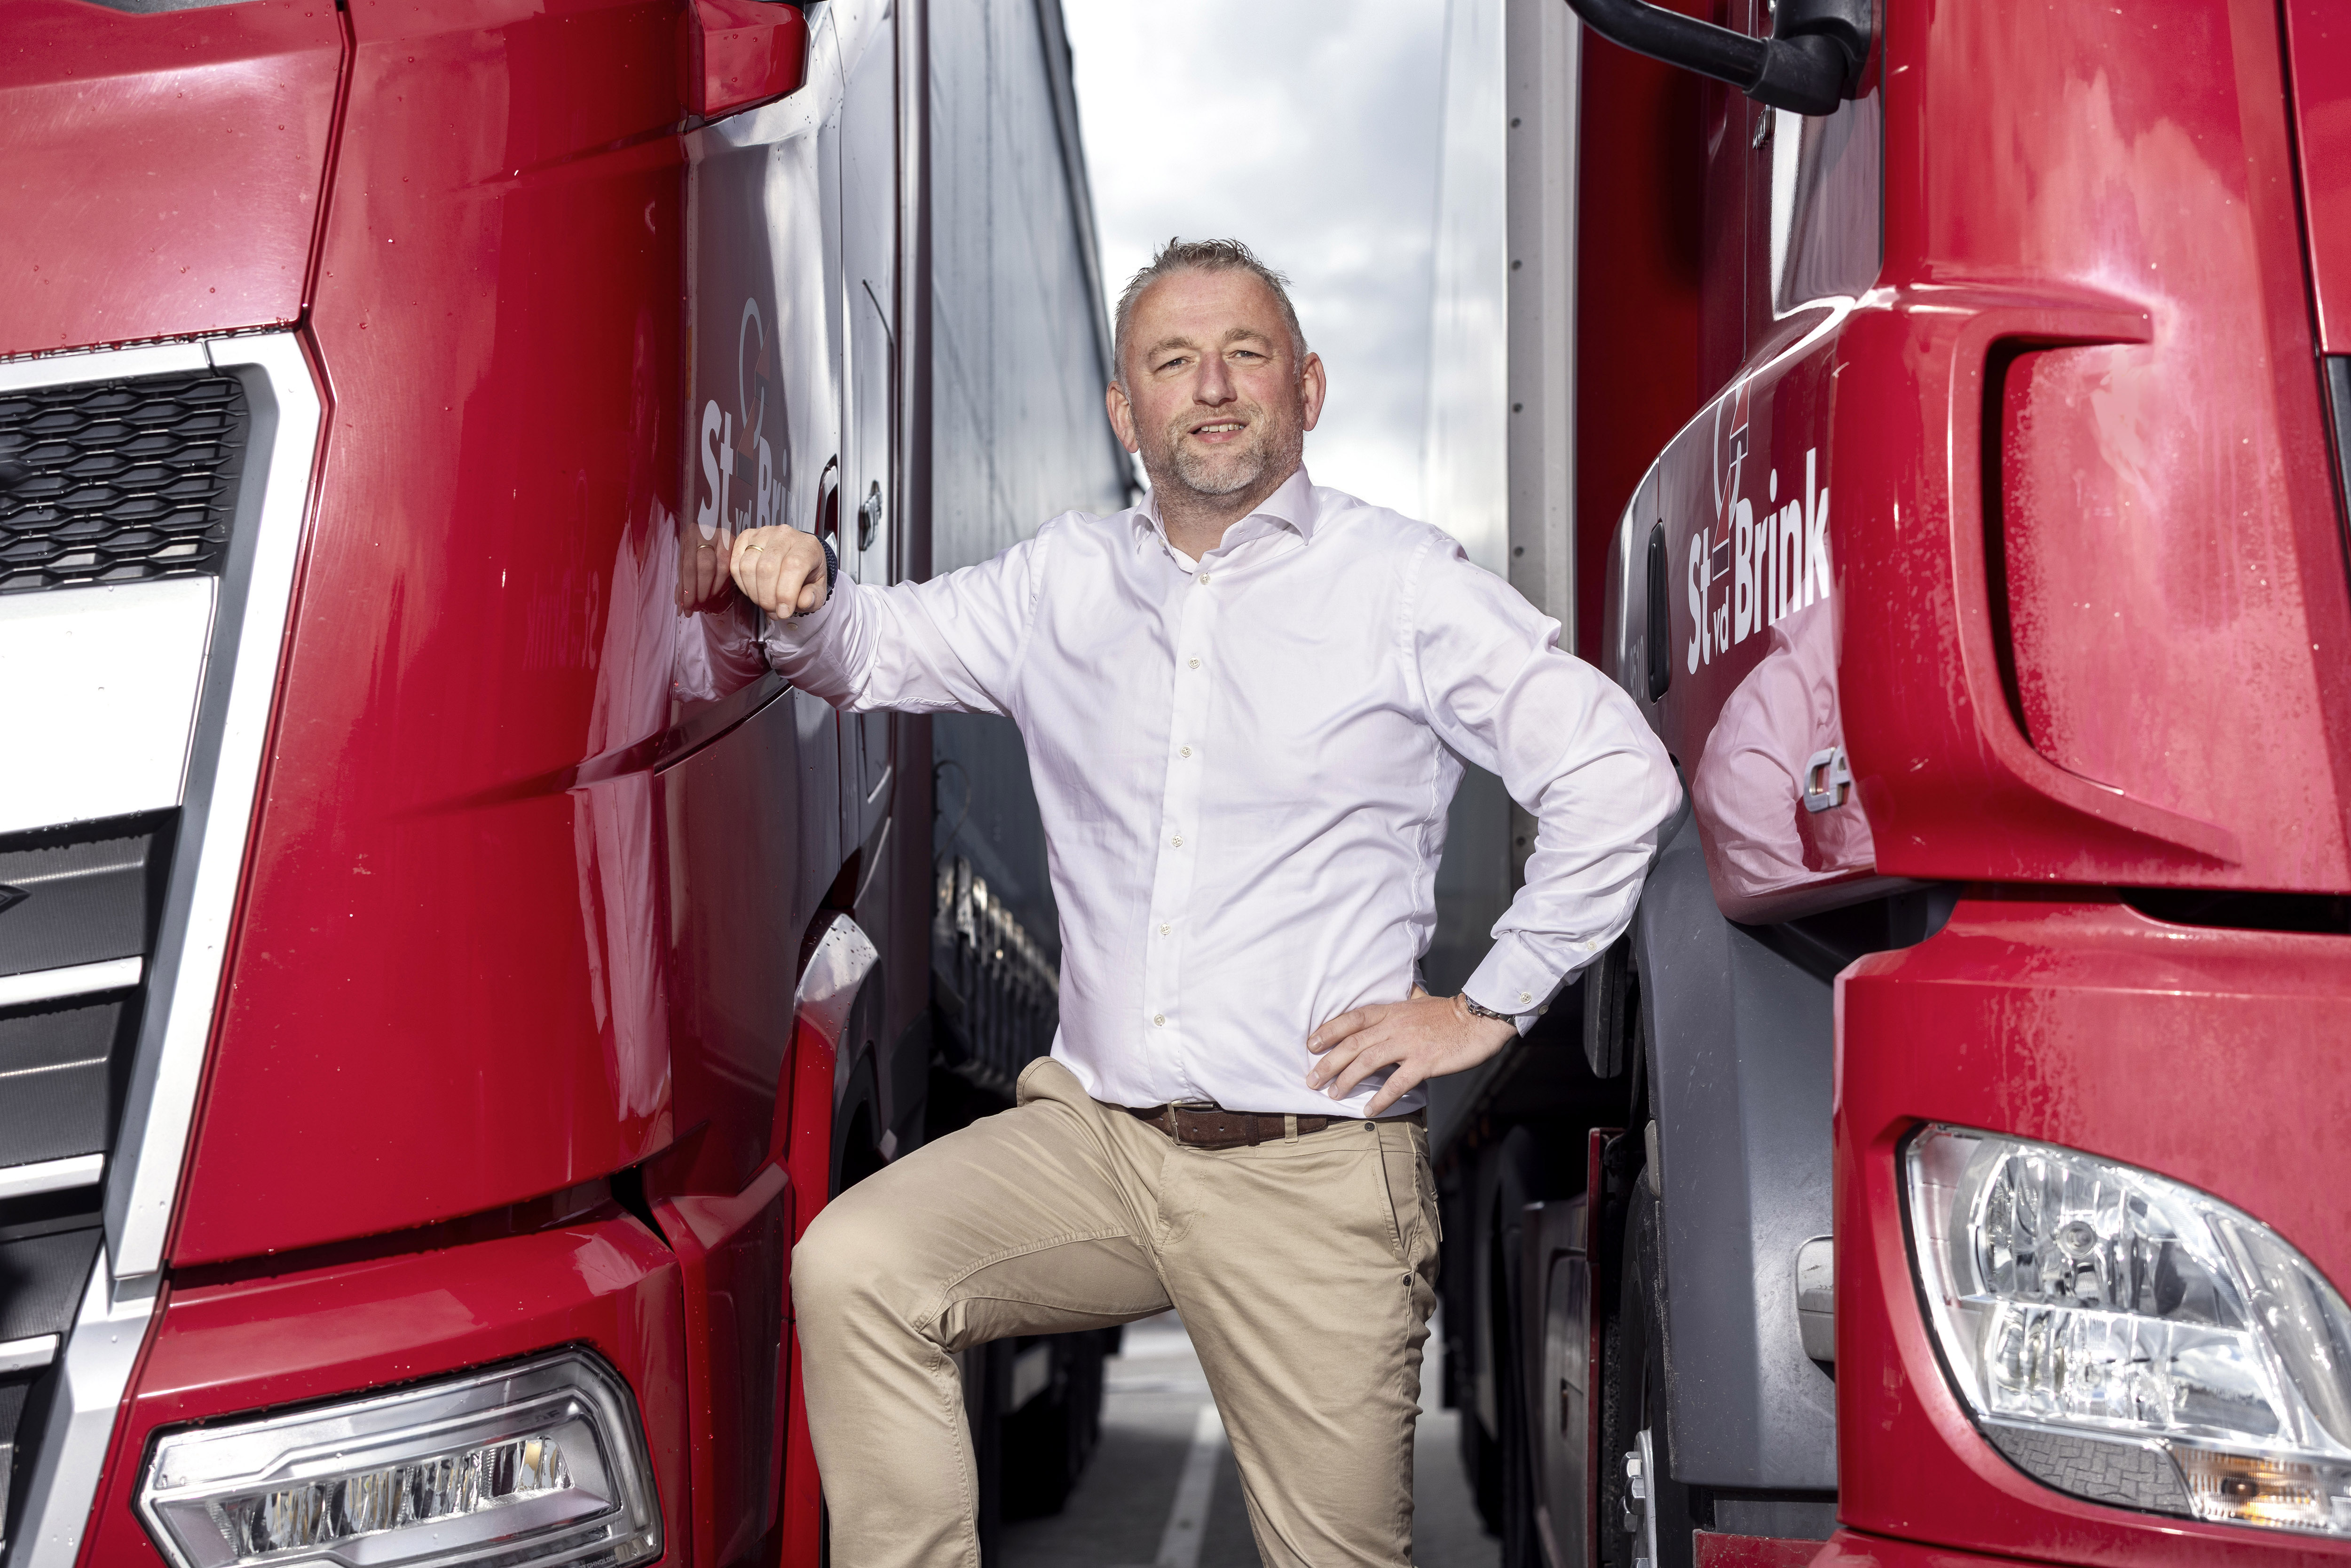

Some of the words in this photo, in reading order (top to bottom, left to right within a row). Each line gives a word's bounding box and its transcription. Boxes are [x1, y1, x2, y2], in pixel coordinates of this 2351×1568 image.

[698, 400, 733, 551] St
[1688, 527, 1711, 674] St
[1713, 585, 1729, 657] vd
[1734, 447, 1830, 645] Brink
[1630, 635, 1644, 704] 9510
